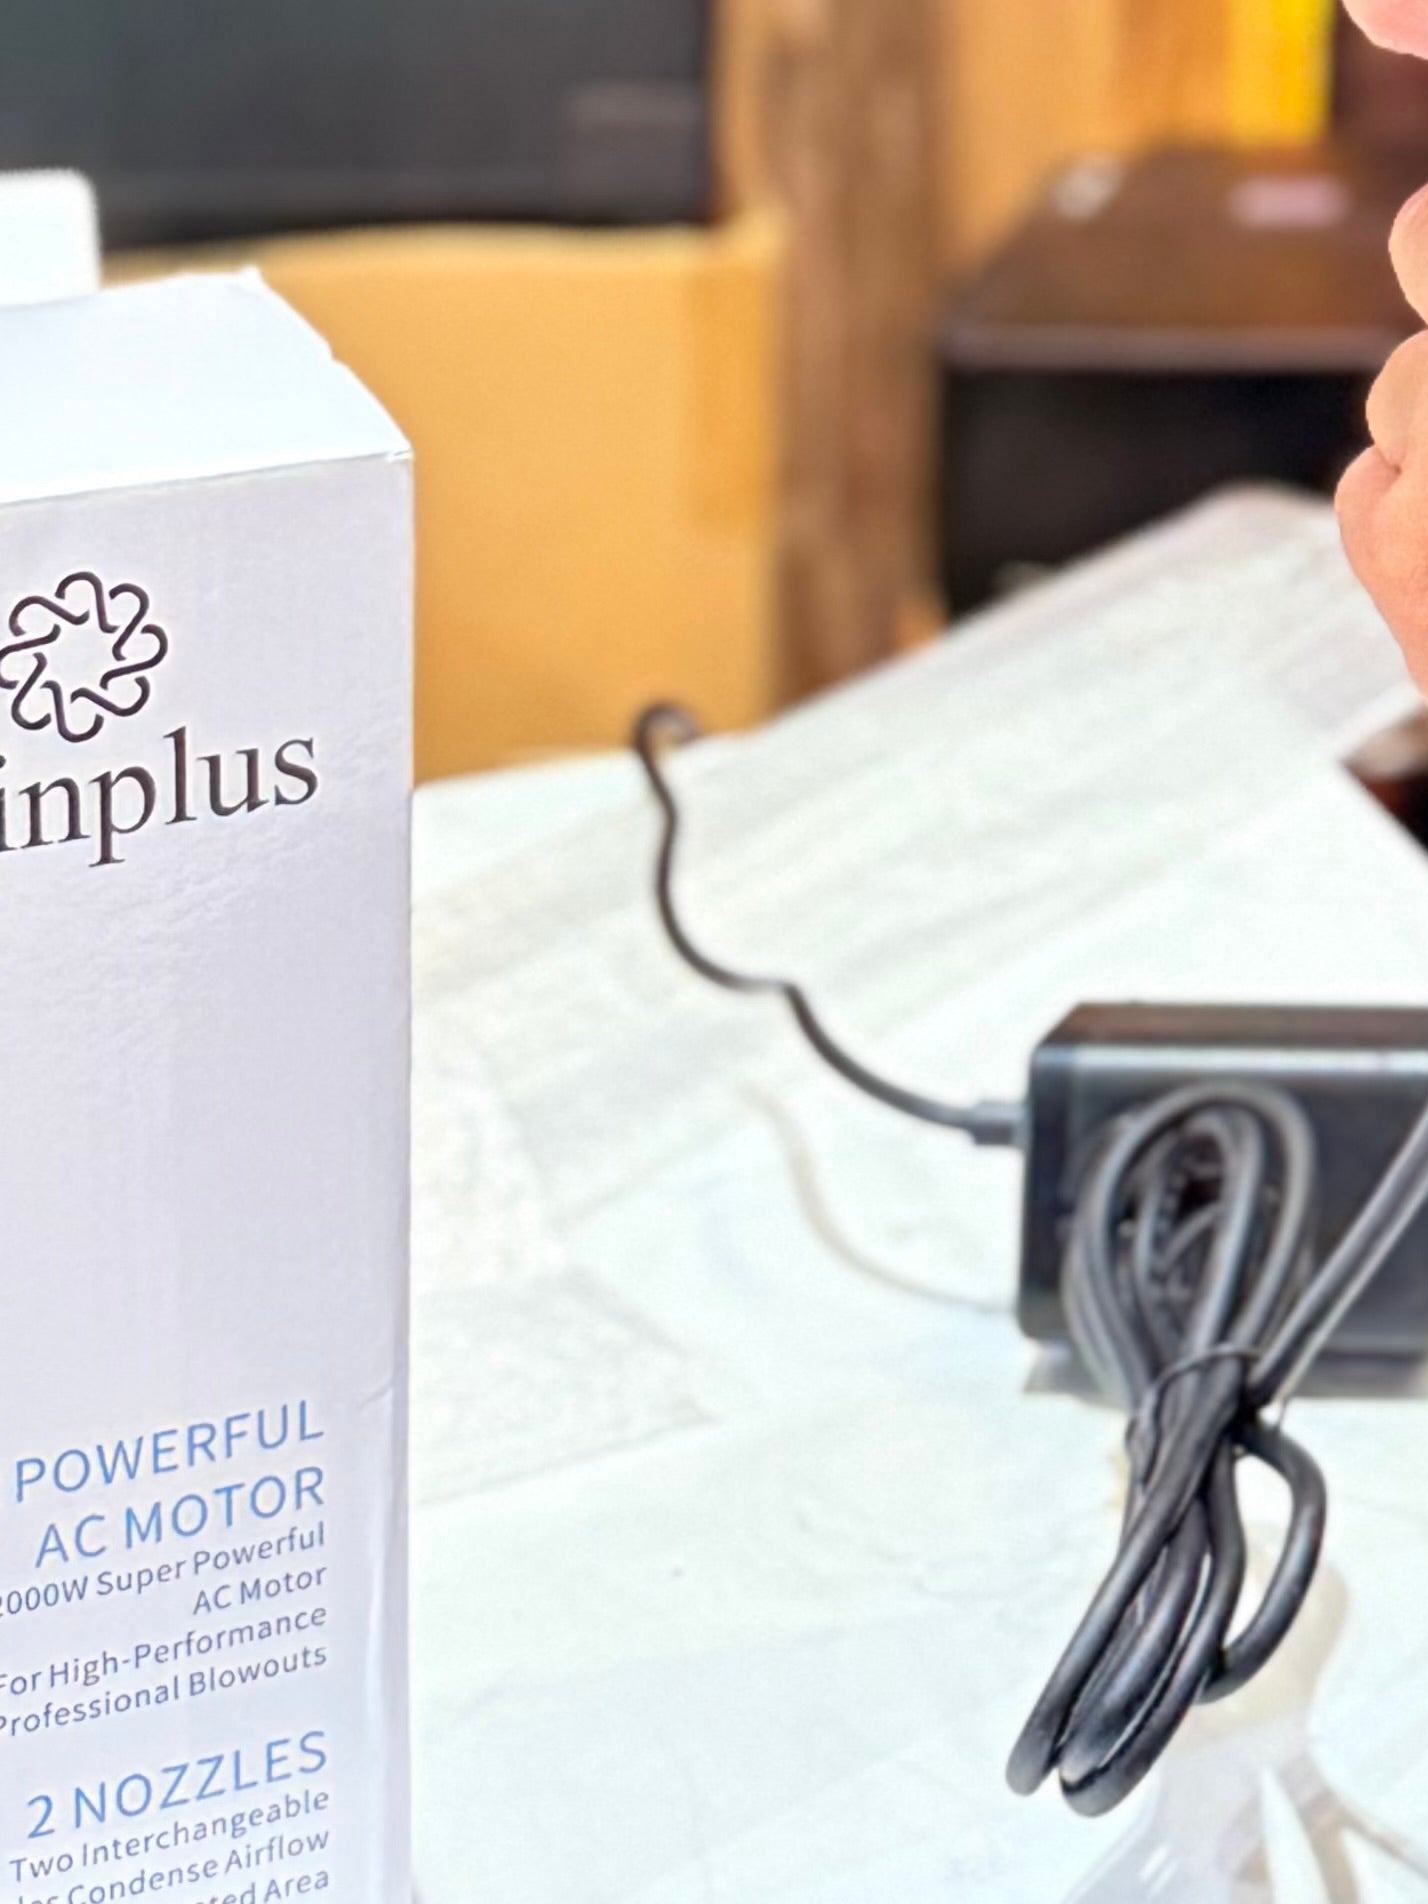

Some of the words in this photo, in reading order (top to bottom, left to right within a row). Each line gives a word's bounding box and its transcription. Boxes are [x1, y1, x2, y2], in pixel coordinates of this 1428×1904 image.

[15, 1399, 325, 1504] POWERFUL
[34, 1513, 107, 1569] AC
[125, 1465, 324, 1550] MOTOR
[0, 1575, 89, 1617] 000W
[96, 1558, 187, 1595] Super
[193, 1520, 325, 1575] Powerful
[193, 1584, 232, 1616] AC
[240, 1565, 327, 1605] Motor
[50, 1606, 327, 1687] High-Performance
[189, 1645, 327, 1697] Blowouts
[27, 1794, 55, 1840] 2
[74, 1730, 328, 1829] NOZZLES
[9, 1852, 74, 1883] Two
[82, 1788, 330, 1867] Interchangeable
[68, 1859, 219, 1904] Condense
[224, 1830, 330, 1875] Airflow
[263, 1869, 330, 1903] Area
